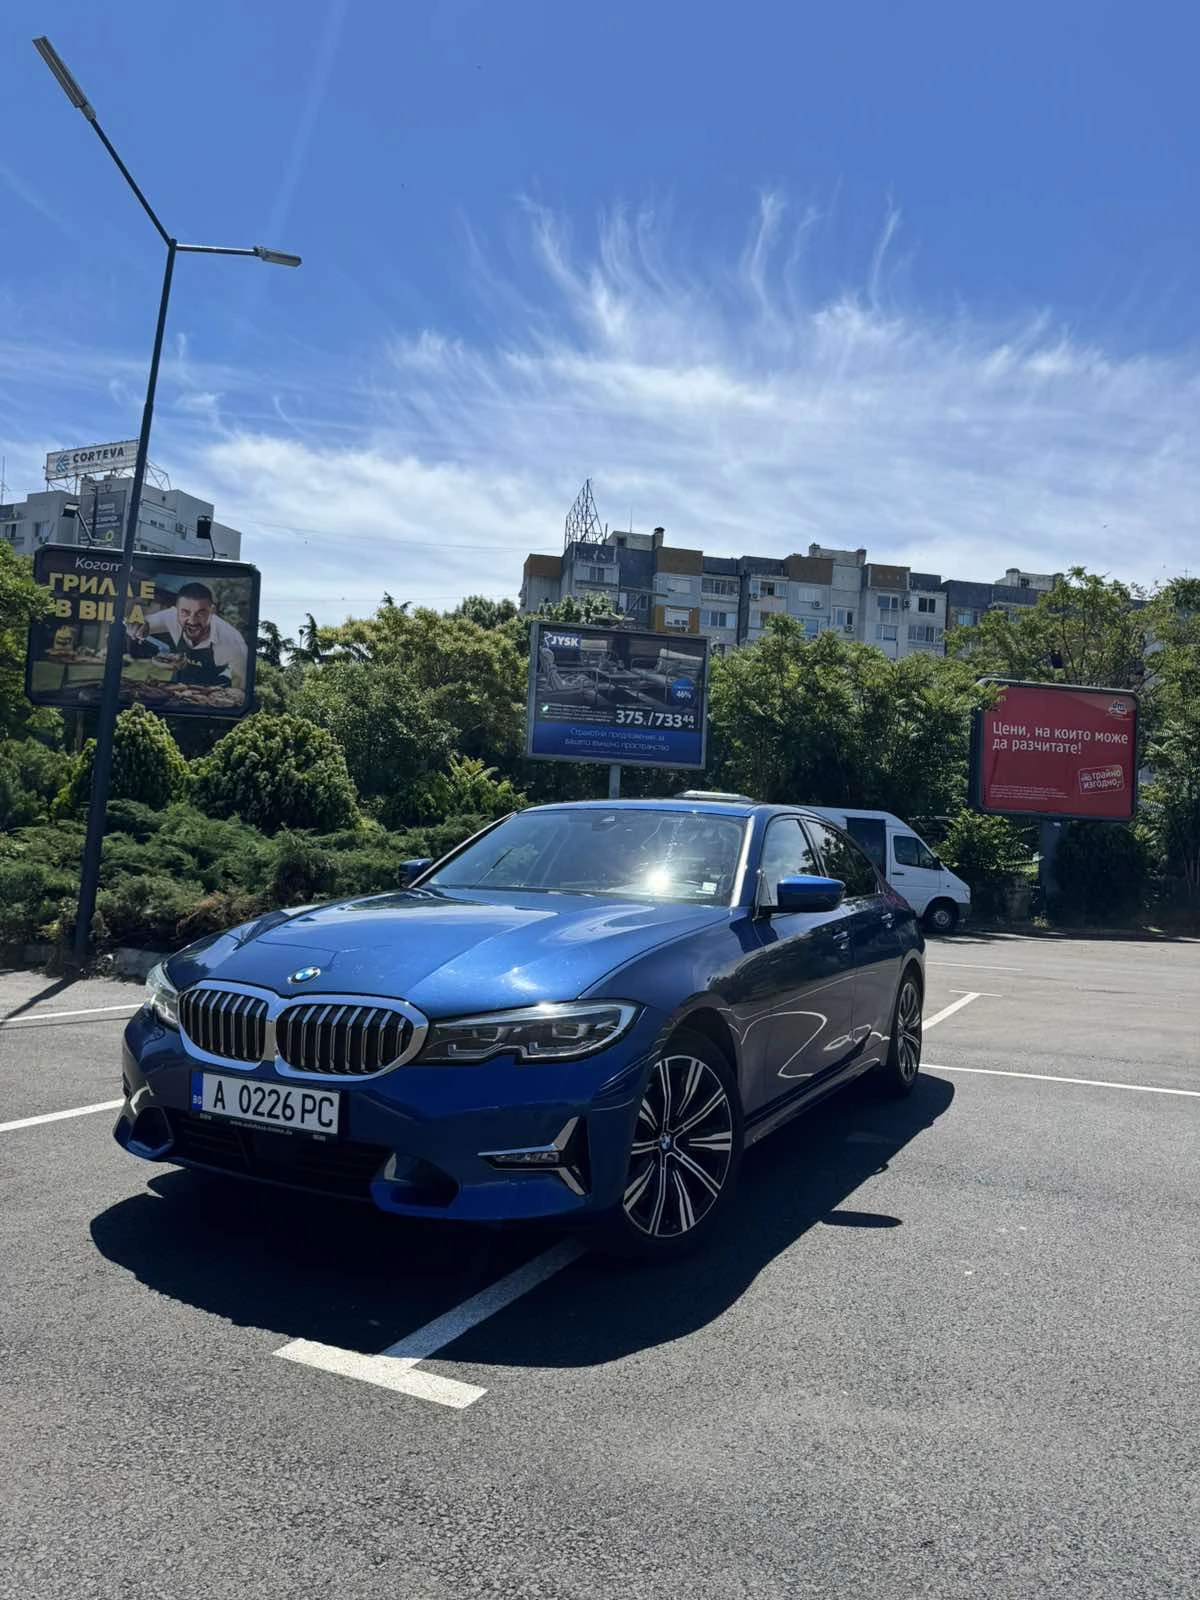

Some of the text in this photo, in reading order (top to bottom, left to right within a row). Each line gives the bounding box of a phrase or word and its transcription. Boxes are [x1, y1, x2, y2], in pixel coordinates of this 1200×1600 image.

[73, 447, 124, 463] CORTEVA
[75, 557, 133, 571] Когат
[49, 572, 134, 597] ГРИЛ
[79, 600, 145, 624] BILA
[551, 635, 579, 647] JYSK
[993, 722, 1128, 744] Цени, на които може
[992, 739, 1082, 755] да разчитате!
[213, 1080, 226, 1110] A
[239, 1085, 295, 1121] 0226
[300, 1093, 334, 1128] PC
